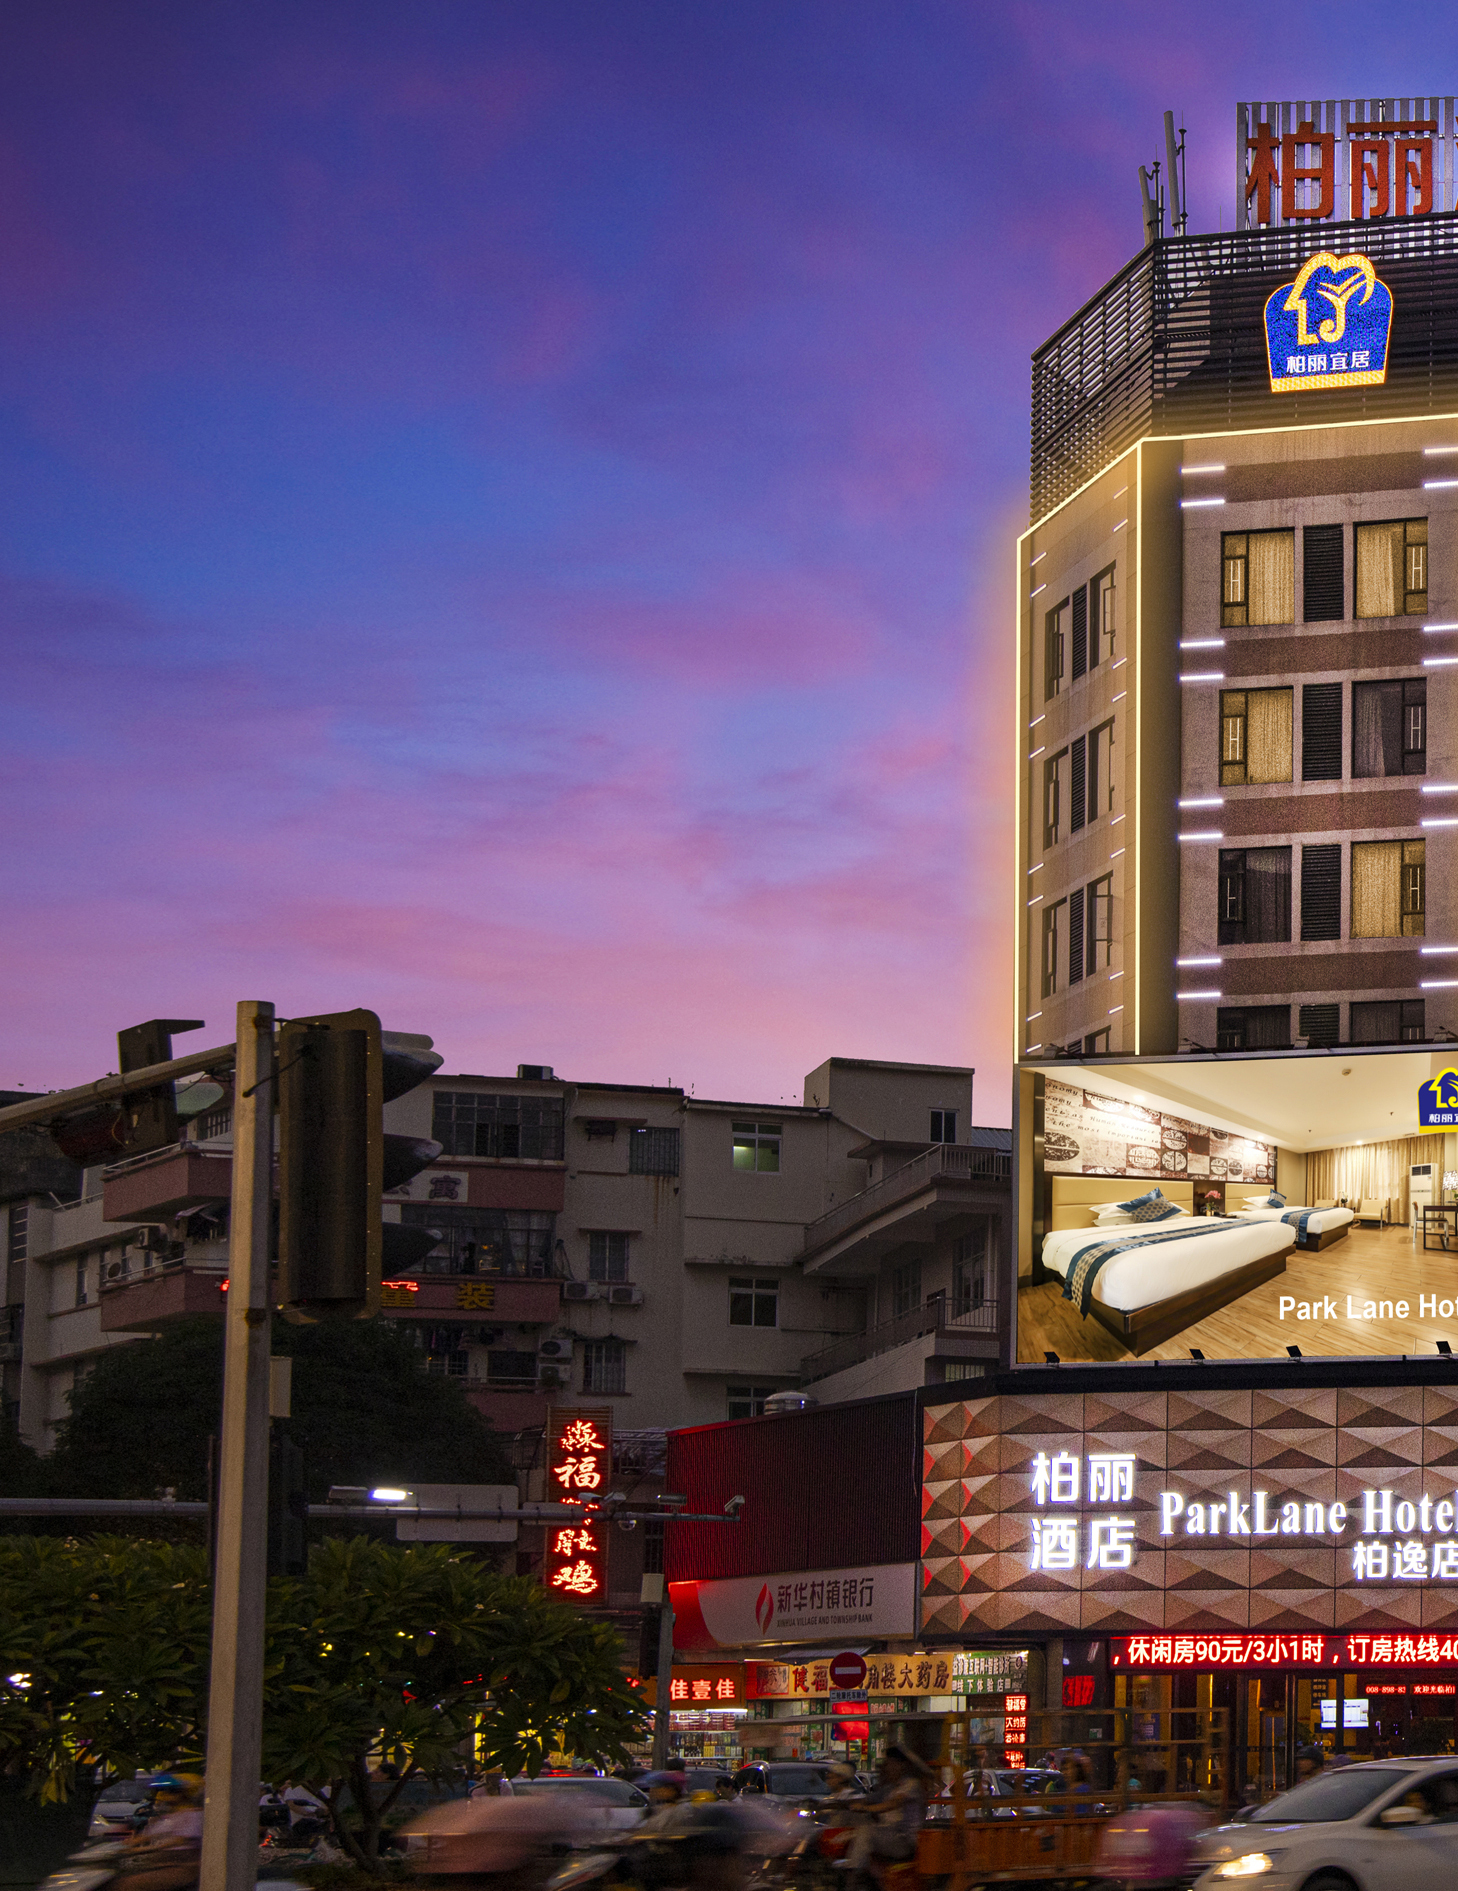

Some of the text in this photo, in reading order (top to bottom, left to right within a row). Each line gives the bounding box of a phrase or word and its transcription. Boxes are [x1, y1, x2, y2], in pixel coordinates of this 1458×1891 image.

[1286, 350, 1371, 375] 柏丽宜居
[1279, 1295, 1338, 1321] Park
[1346, 1295, 1410, 1320] Lane
[1031, 1452, 1137, 1504] 柏丽
[1160, 1490, 1347, 1537] ParkLane
[1031, 1515, 1137, 1570] 酒店
[777, 1577, 874, 1614] 新华村镇银行
[777, 1613, 873, 1628] XINHUA VILLAGE AND TOWNSHIP BANK
[670, 1678, 735, 1700] 佳壹佳
[1413, 1685, 1456, 1694] 欢迎光临柏
